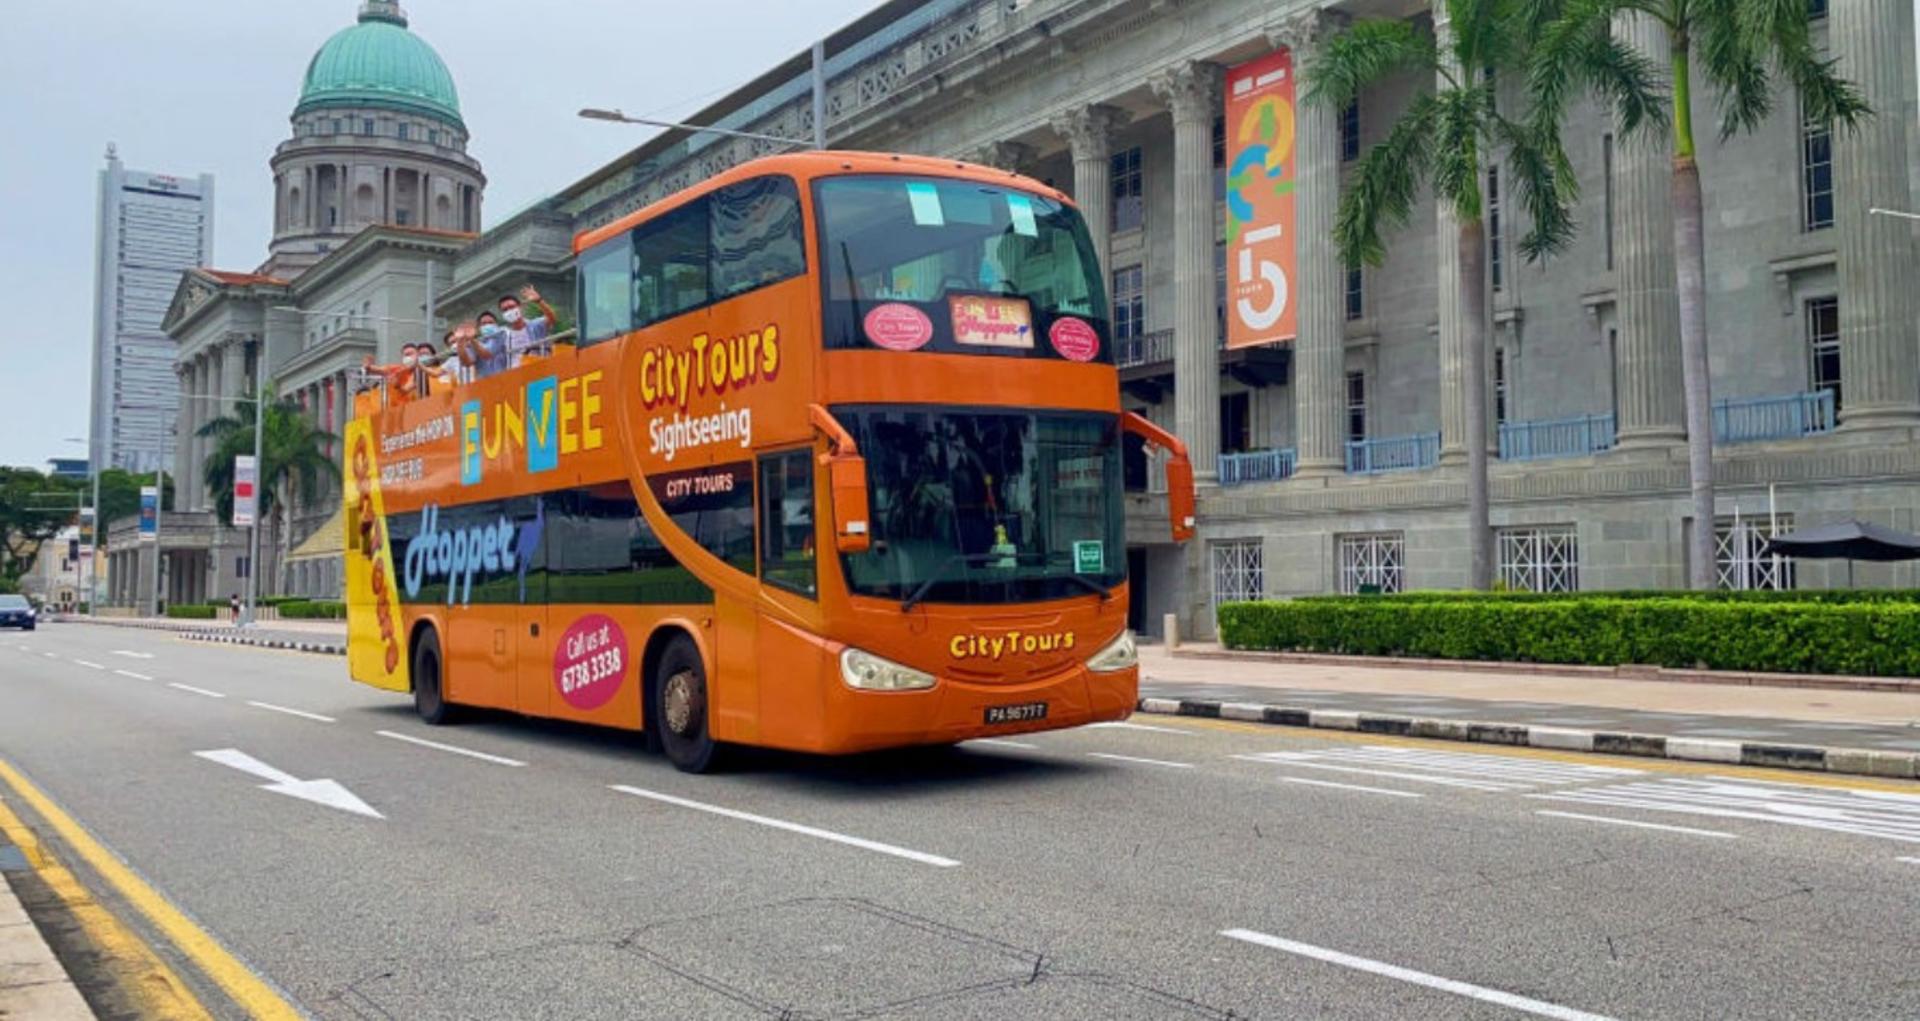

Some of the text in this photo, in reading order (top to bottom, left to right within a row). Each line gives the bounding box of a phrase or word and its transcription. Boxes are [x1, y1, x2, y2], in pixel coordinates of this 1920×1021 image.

[650, 401, 751, 461] Sightseeing
[667, 472, 734, 498] CITY TOURS
[404, 503, 515, 609] Hopper
[567, 622, 610, 660] Call us at
[562, 646, 622, 694] 6738 3338
